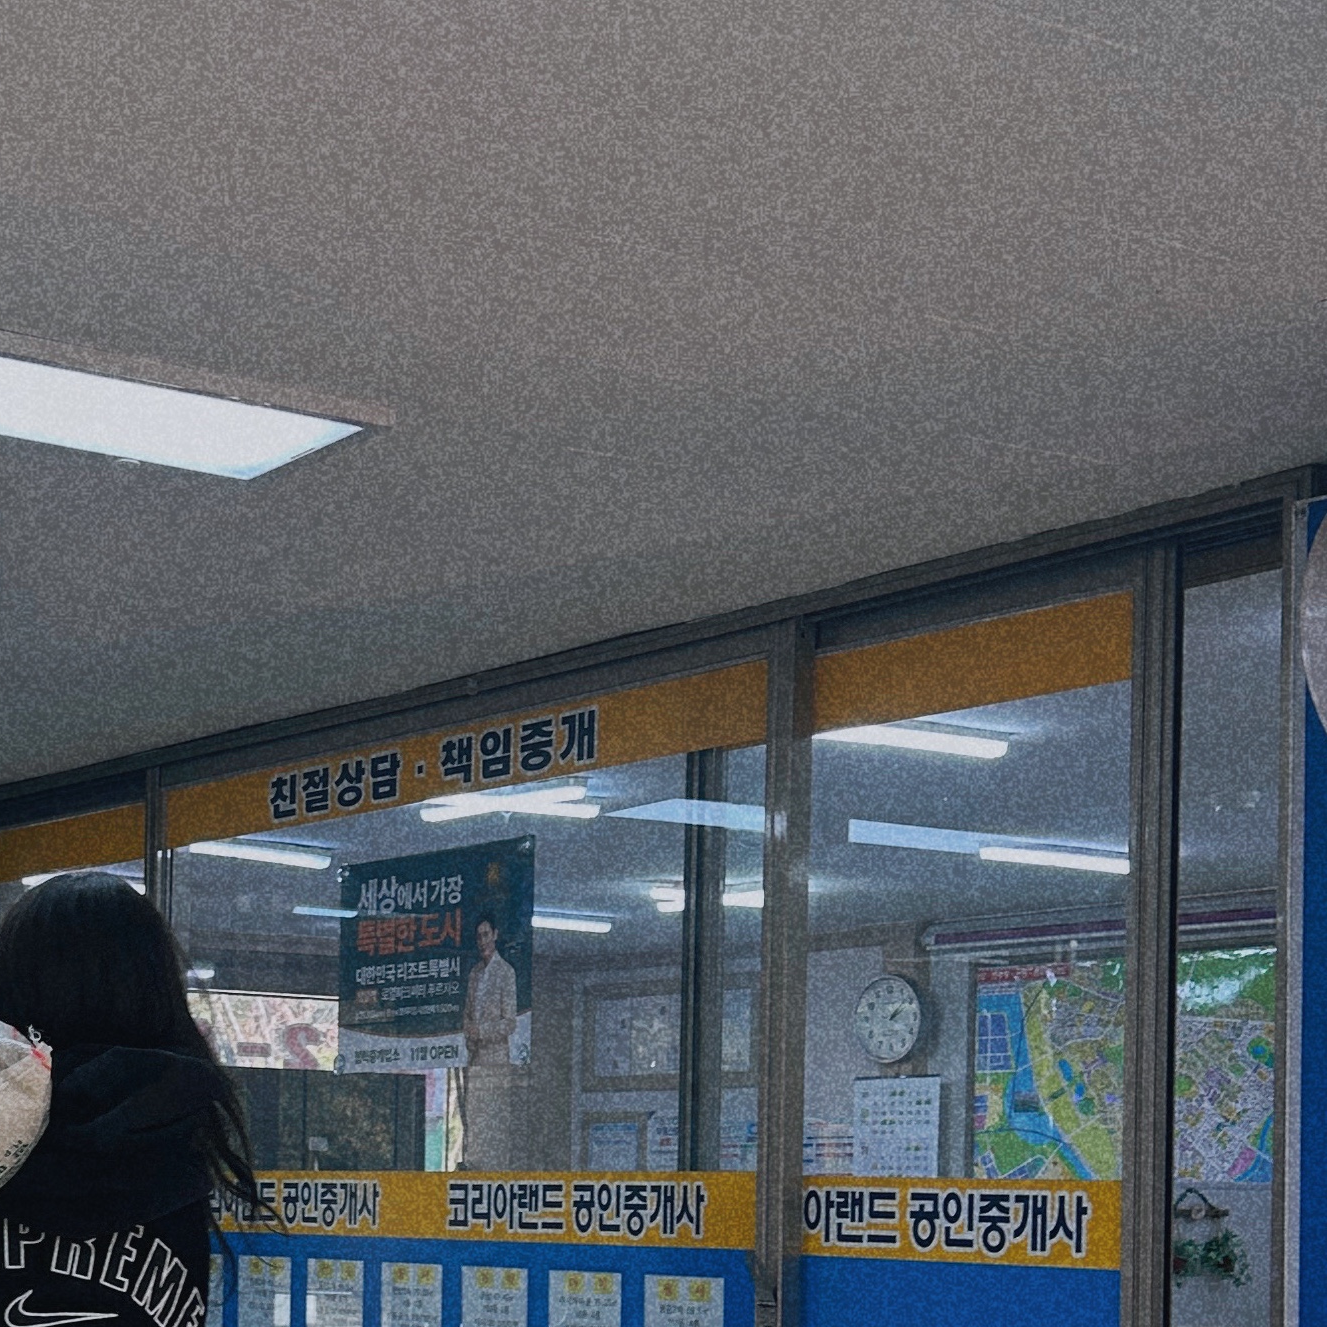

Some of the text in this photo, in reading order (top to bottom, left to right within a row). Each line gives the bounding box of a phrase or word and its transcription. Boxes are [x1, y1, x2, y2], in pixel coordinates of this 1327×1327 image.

[270, 753, 400, 820] 친절상담
[442, 709, 596, 783] 책임중개
[358, 874, 463, 915] 세상에서 가장
[357, 908, 462, 956] 특별한 도시
[430, 1045, 459, 1060] OPEN
[282, 1181, 379, 1227] 공인중개사
[449, 1183, 705, 1237] 코리아랜드 공인중개사
[803, 1190, 1088, 1253] 아랜드 공인중개사
